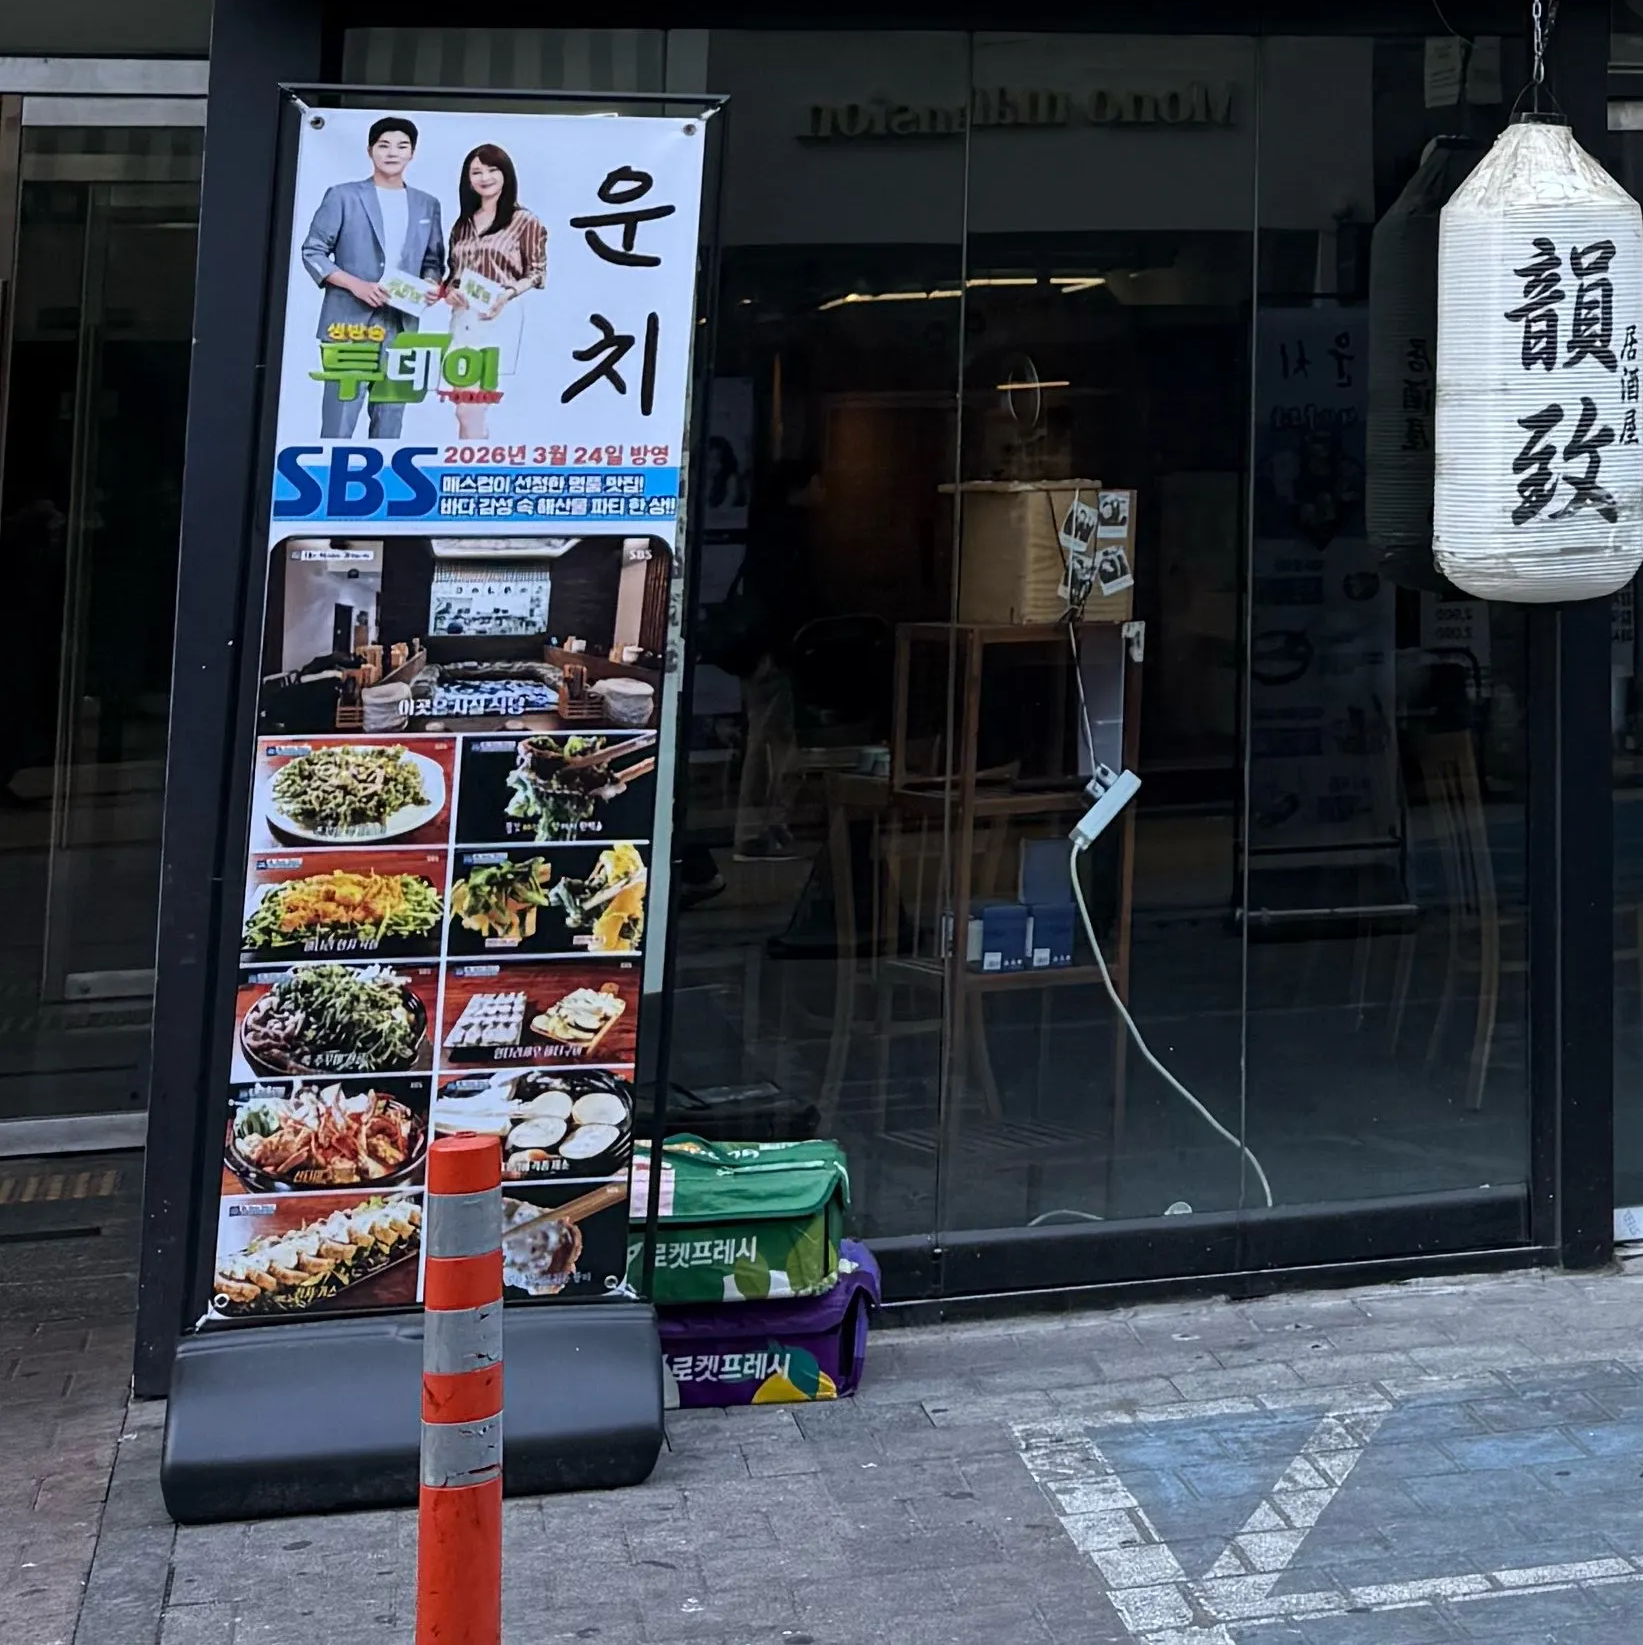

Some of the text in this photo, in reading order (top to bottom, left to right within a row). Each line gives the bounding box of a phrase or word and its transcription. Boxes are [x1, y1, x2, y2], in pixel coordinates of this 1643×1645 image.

[561, 165, 677, 416] 운치
[308, 334, 500, 403] 투데이
[443, 444, 669, 467] 2026년 3월 24일 방영
[273, 446, 439, 517] SBS
[514, 474, 566, 494] 선정한
[440, 497, 476, 516] 바다
[479, 497, 514, 516] 감성
[516, 498, 533, 515] 속
[537, 497, 588, 516] 해산물
[591, 497, 625, 516] 파티
[673, 1352, 792, 1383] 로켓프레시
